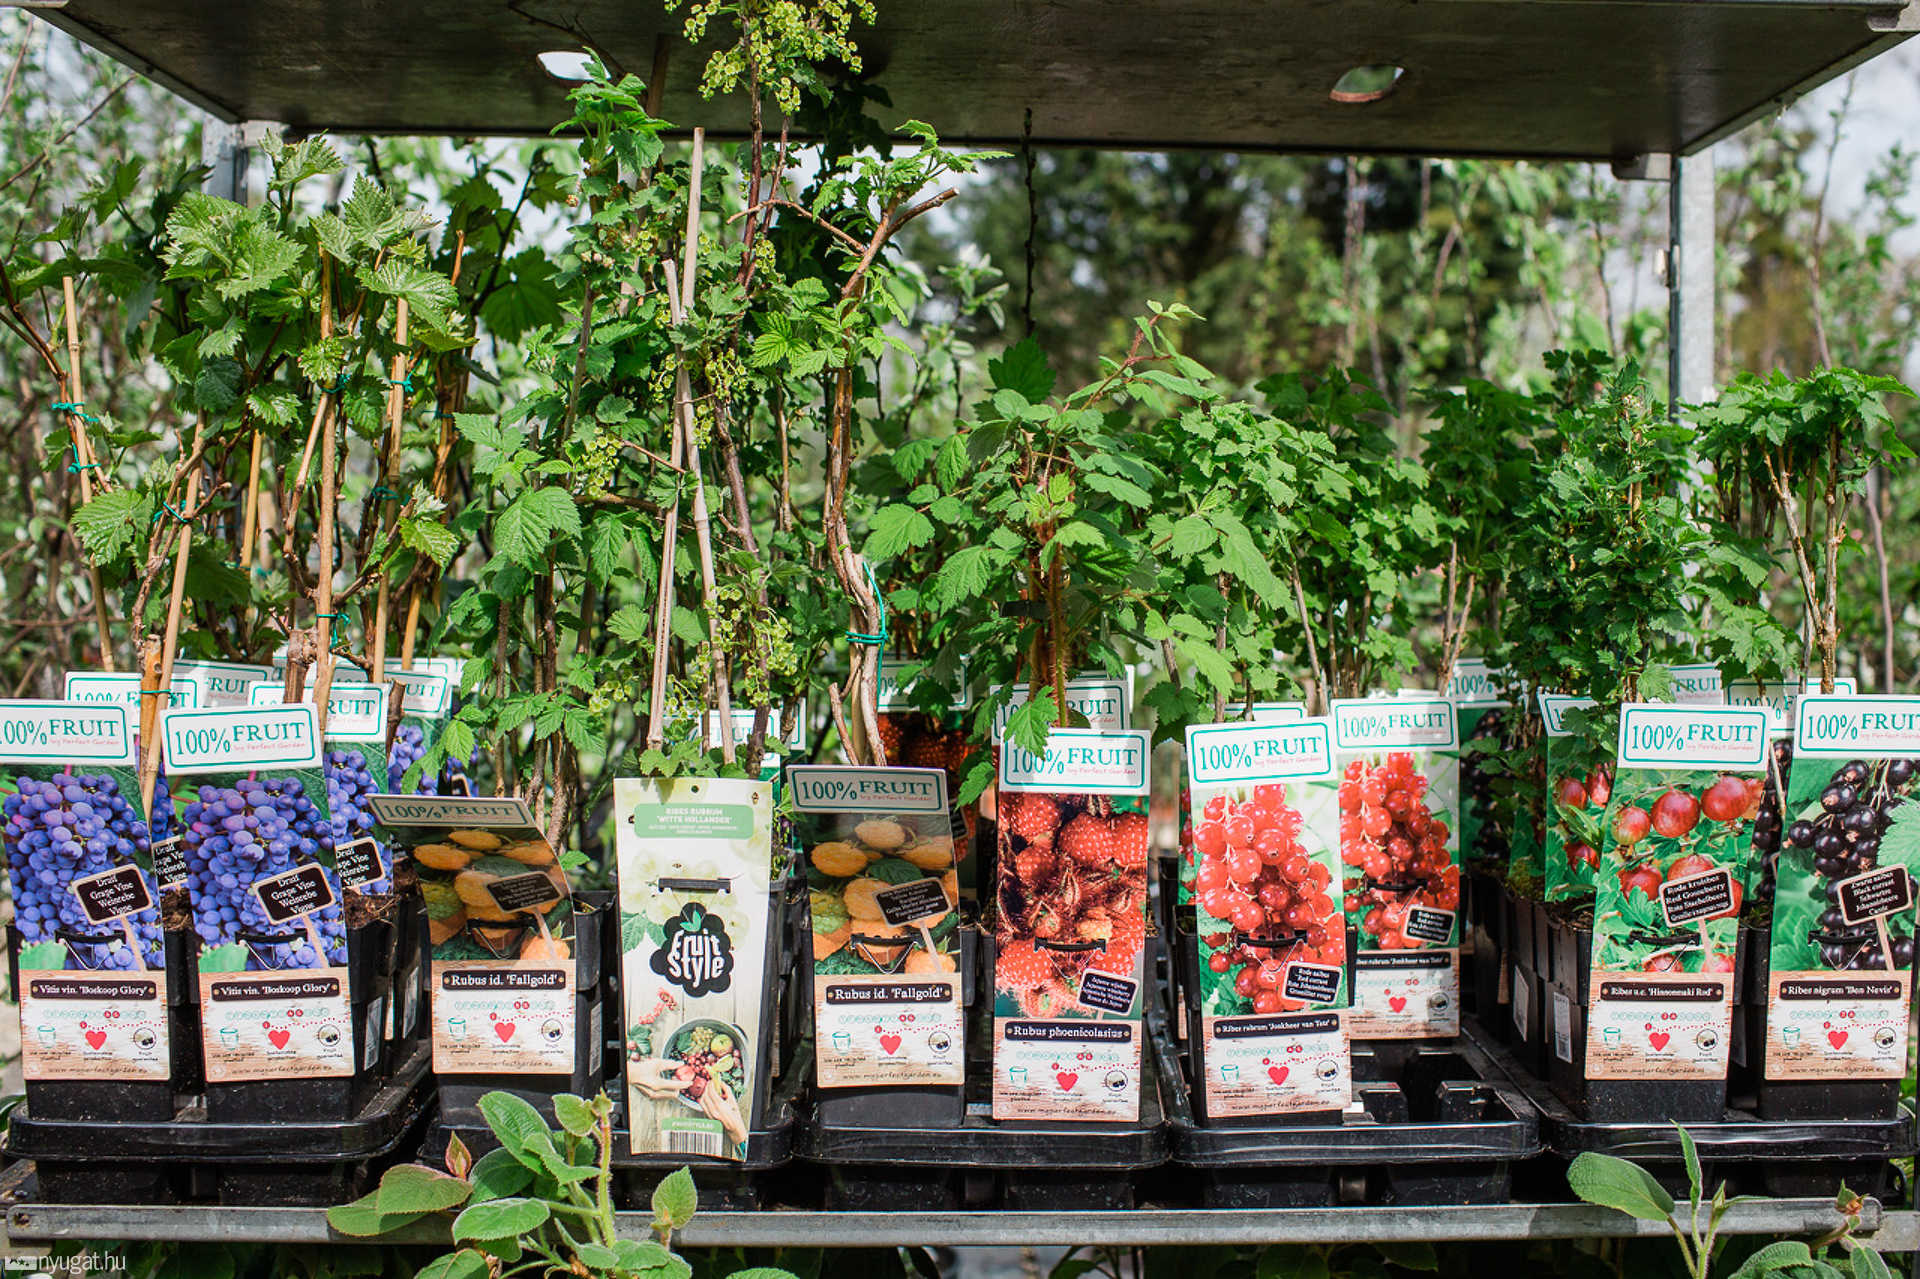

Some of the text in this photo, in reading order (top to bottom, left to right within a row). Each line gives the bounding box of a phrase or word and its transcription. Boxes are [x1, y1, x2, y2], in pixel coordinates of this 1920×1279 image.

[206, 677, 250, 693] RUI
[406, 683, 440, 697] UIT
[1453, 674, 1494, 695] 100%
[0, 719, 119, 745] 00% FRUIT
[1344, 713, 1446, 738] 100% FRUIT
[1807, 714, 1858, 740] 100%
[175, 722, 305, 755] 100% FRUIT
[1631, 723, 1758, 751] 100% FRUIT
[1067, 747, 1138, 766] FRUIT
[1200, 736, 1322, 770] 100% FRUIT
[801, 780, 933, 800] 100% FRUIT
[383, 804, 514, 819] 100% FRUIT
[672, 928, 721, 957] Fruit
[666, 950, 725, 988] Style
[39, 984, 60, 994] Vitis
[60, 985, 77, 994] vin.
[450, 972, 558, 989] Rubus id. 'Fallgold'
[220, 986, 243, 996] Vitis
[243, 986, 261, 996] vin.
[834, 986, 943, 1001] Rubus id. 'Fallgold'
[1788, 985, 1812, 995] Ribes
[1812, 985, 1844, 996] nigrum
[1013, 1026, 1047, 1036] Rubus
